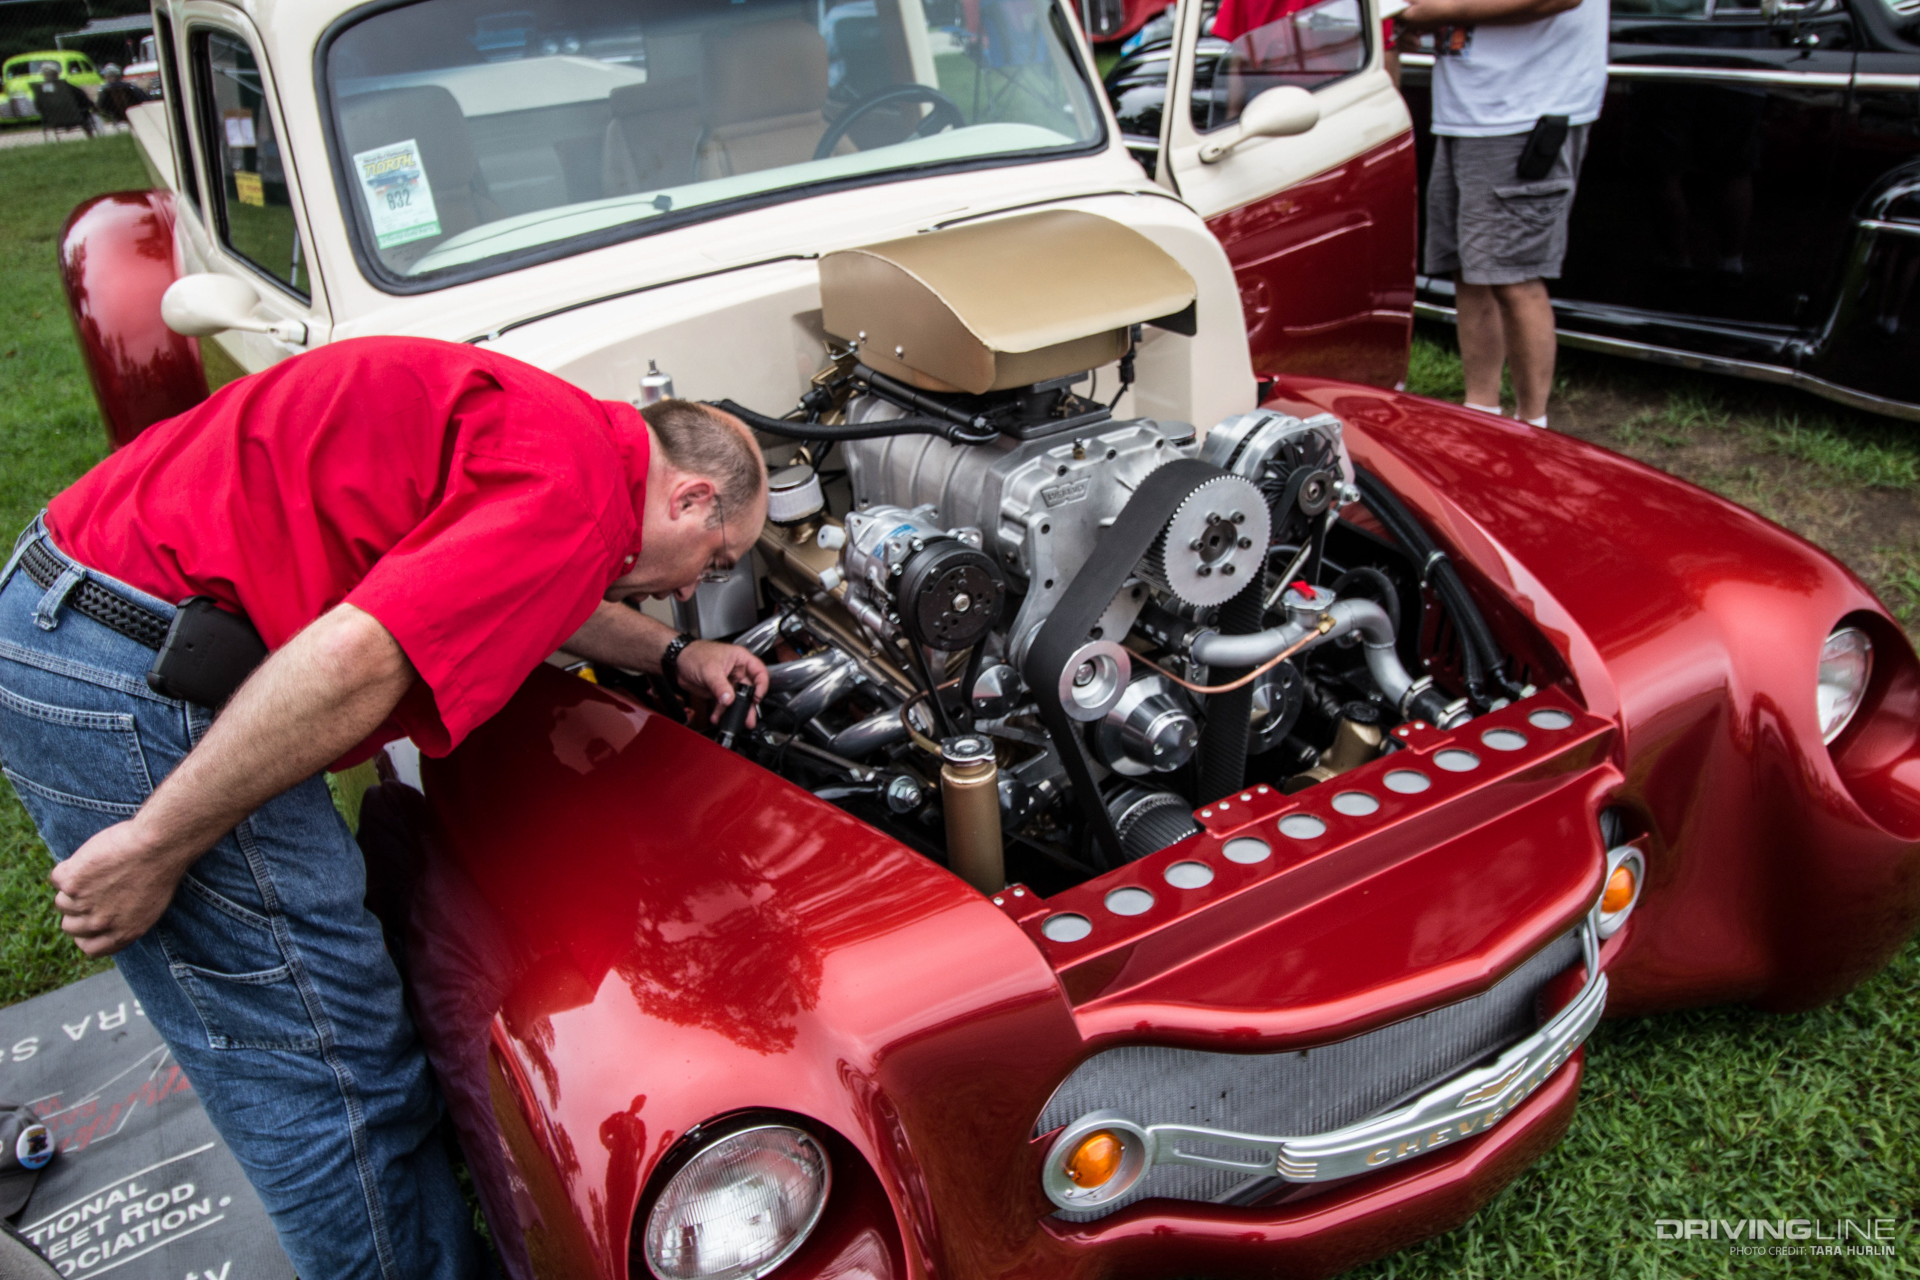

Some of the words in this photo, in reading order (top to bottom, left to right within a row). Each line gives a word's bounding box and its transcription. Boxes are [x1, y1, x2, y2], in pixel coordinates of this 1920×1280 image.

[363, 152, 417, 178] NORTH
[1366, 1034, 1580, 1166] CHEVROLET
[41, 1214, 112, 1260] EET
[121, 1183, 195, 1225] ROD
